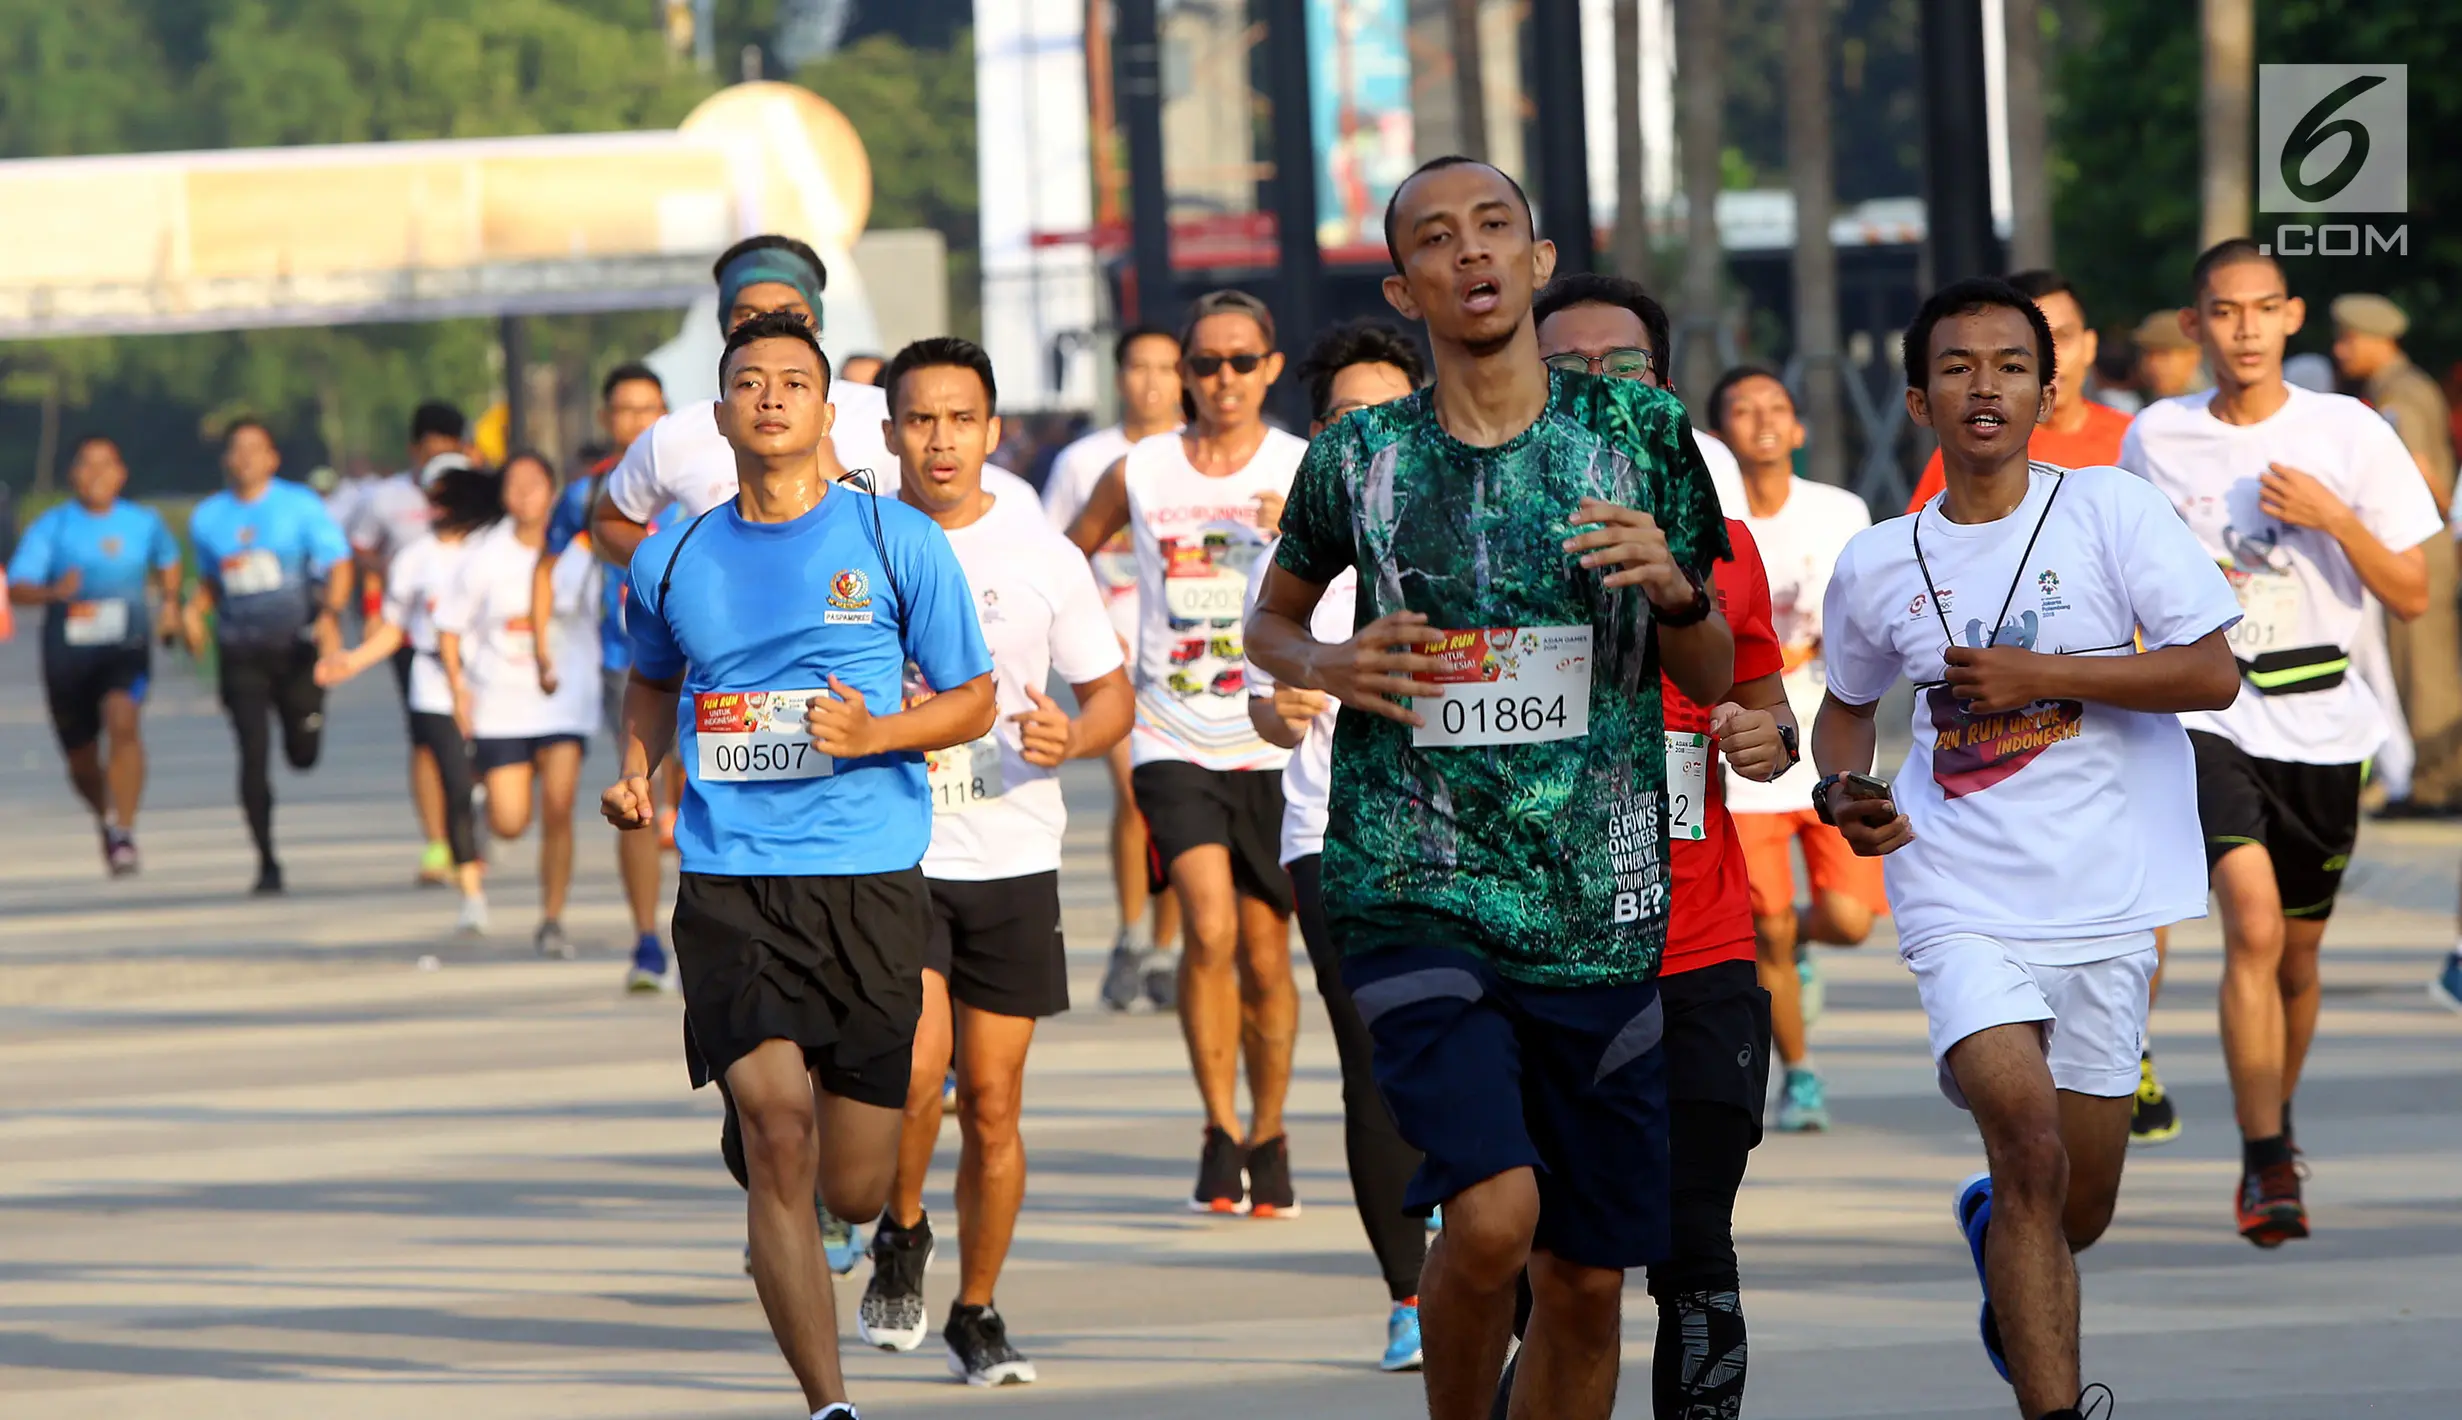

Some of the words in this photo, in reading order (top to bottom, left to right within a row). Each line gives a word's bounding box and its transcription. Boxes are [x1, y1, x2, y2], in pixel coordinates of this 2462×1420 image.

[1450, 632, 1476, 650] RUN
[709, 707, 732, 717] UNTUK
[1442, 695, 1567, 734] 01864
[1934, 728, 1960, 751] FUN
[1967, 717, 2004, 746] RUN
[2009, 708, 2062, 734] UNTUK
[1995, 718, 2082, 756] INDONESIA!
[716, 742, 809, 772] 00507
[931, 776, 985, 806] 118
[1608, 835, 1632, 856] ON
[1615, 871, 1643, 892] YOUR
[1614, 882, 1664, 924] BE?
